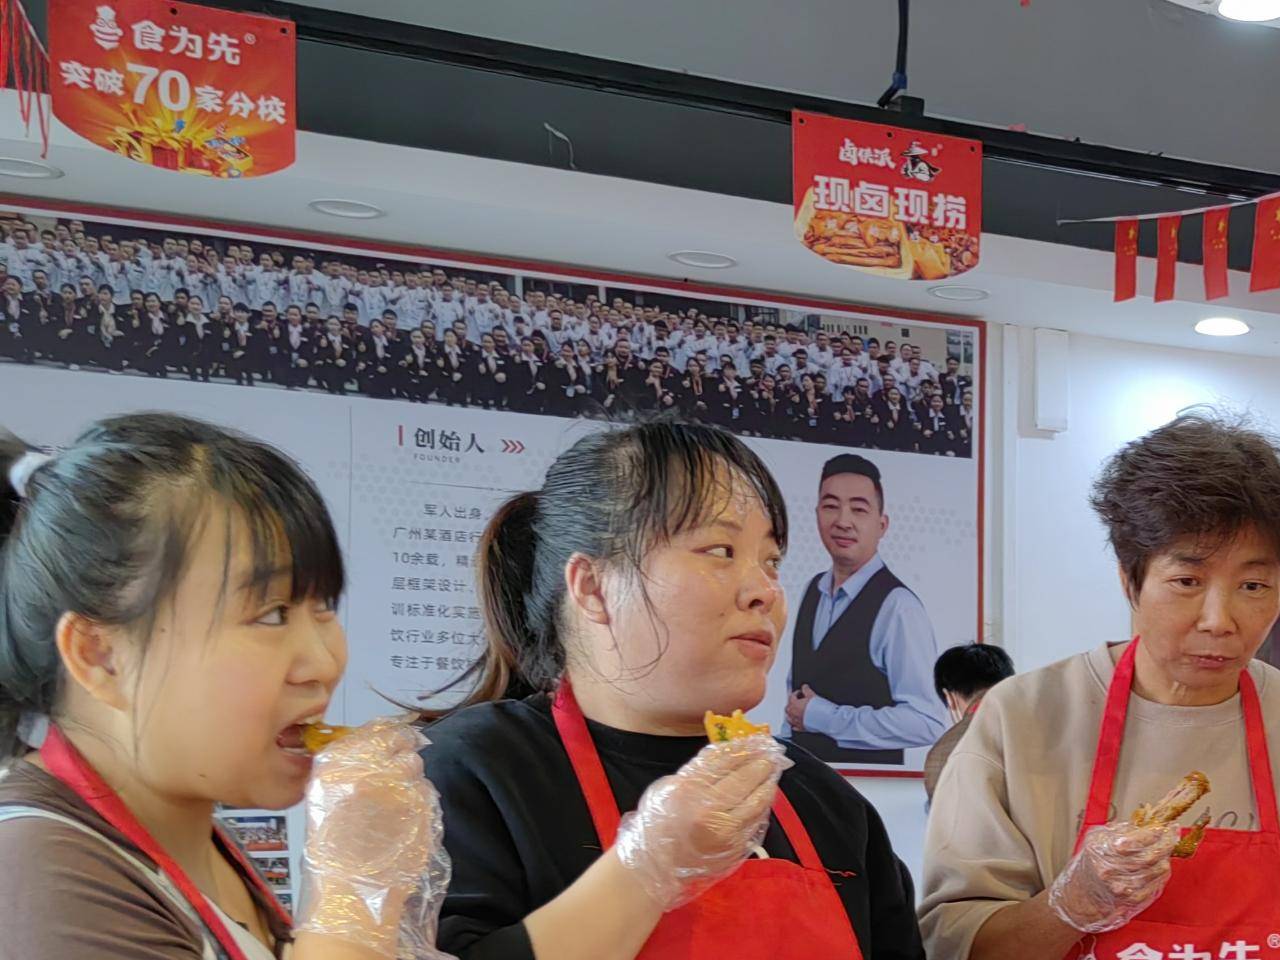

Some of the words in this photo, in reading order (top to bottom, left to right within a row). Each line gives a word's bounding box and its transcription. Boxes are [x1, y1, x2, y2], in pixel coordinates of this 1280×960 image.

[132, 20, 240, 65] 食为先
[59, 60, 287, 124] 突破70家分校
[813, 175, 967, 230] 现卤现捞
[413, 453, 461, 463] FOUNDER
[414, 427, 485, 453] 创始人
